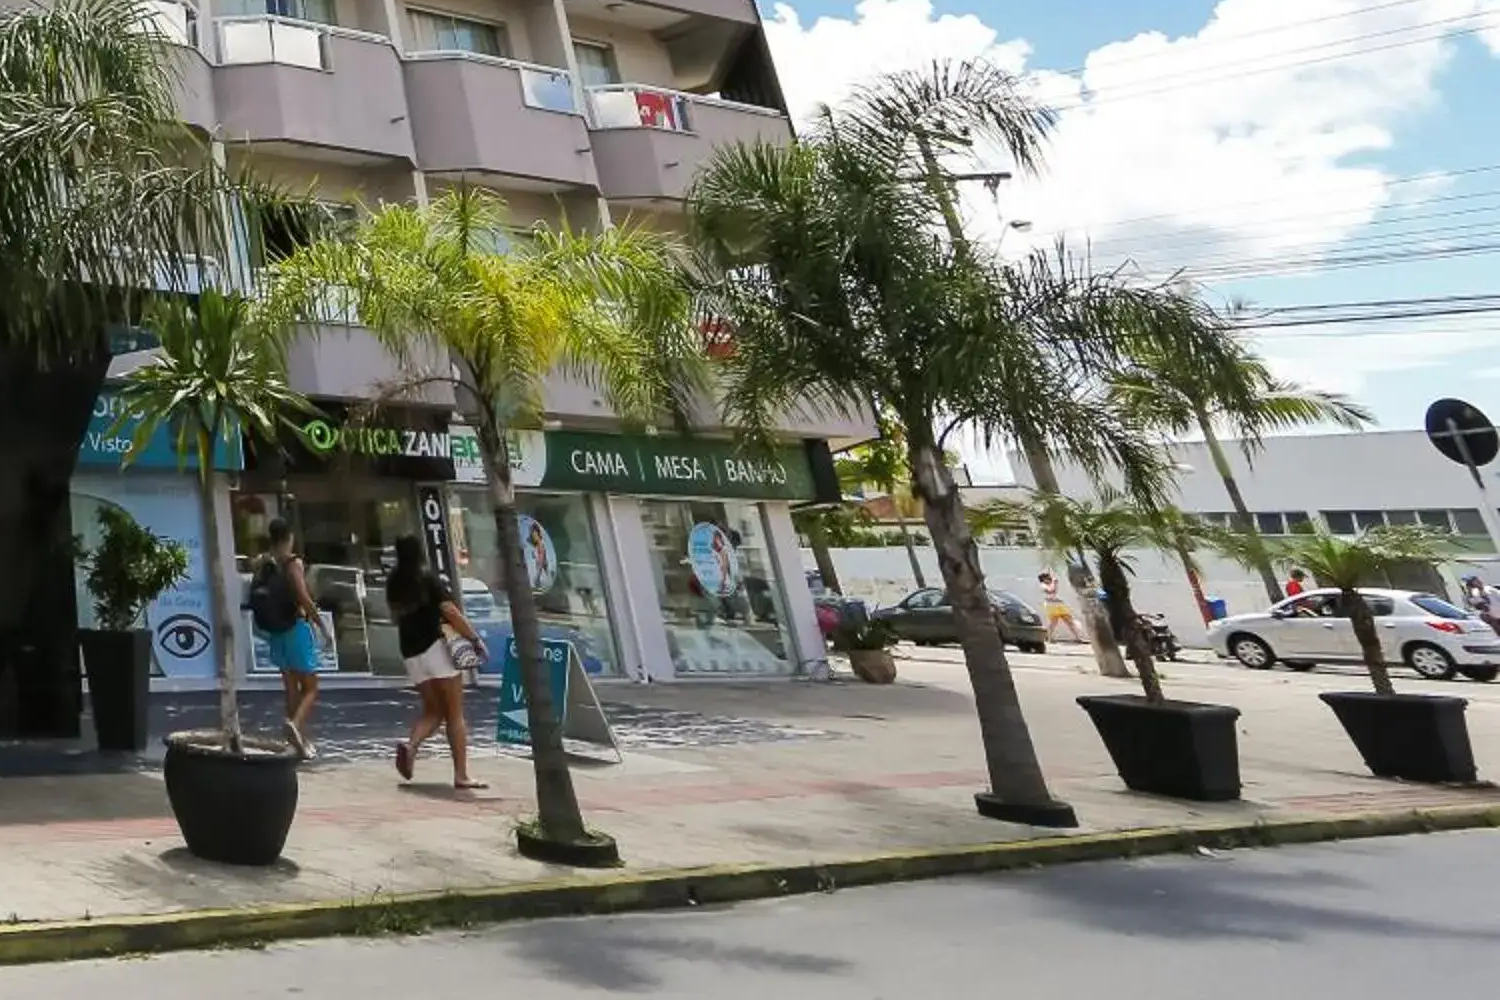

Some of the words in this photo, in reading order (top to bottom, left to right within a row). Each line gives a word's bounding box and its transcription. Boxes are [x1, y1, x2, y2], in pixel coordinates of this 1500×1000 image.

[87, 431, 133, 453] Visto
[570, 449, 629, 477] CAMA
[654, 455, 708, 481] MESA
